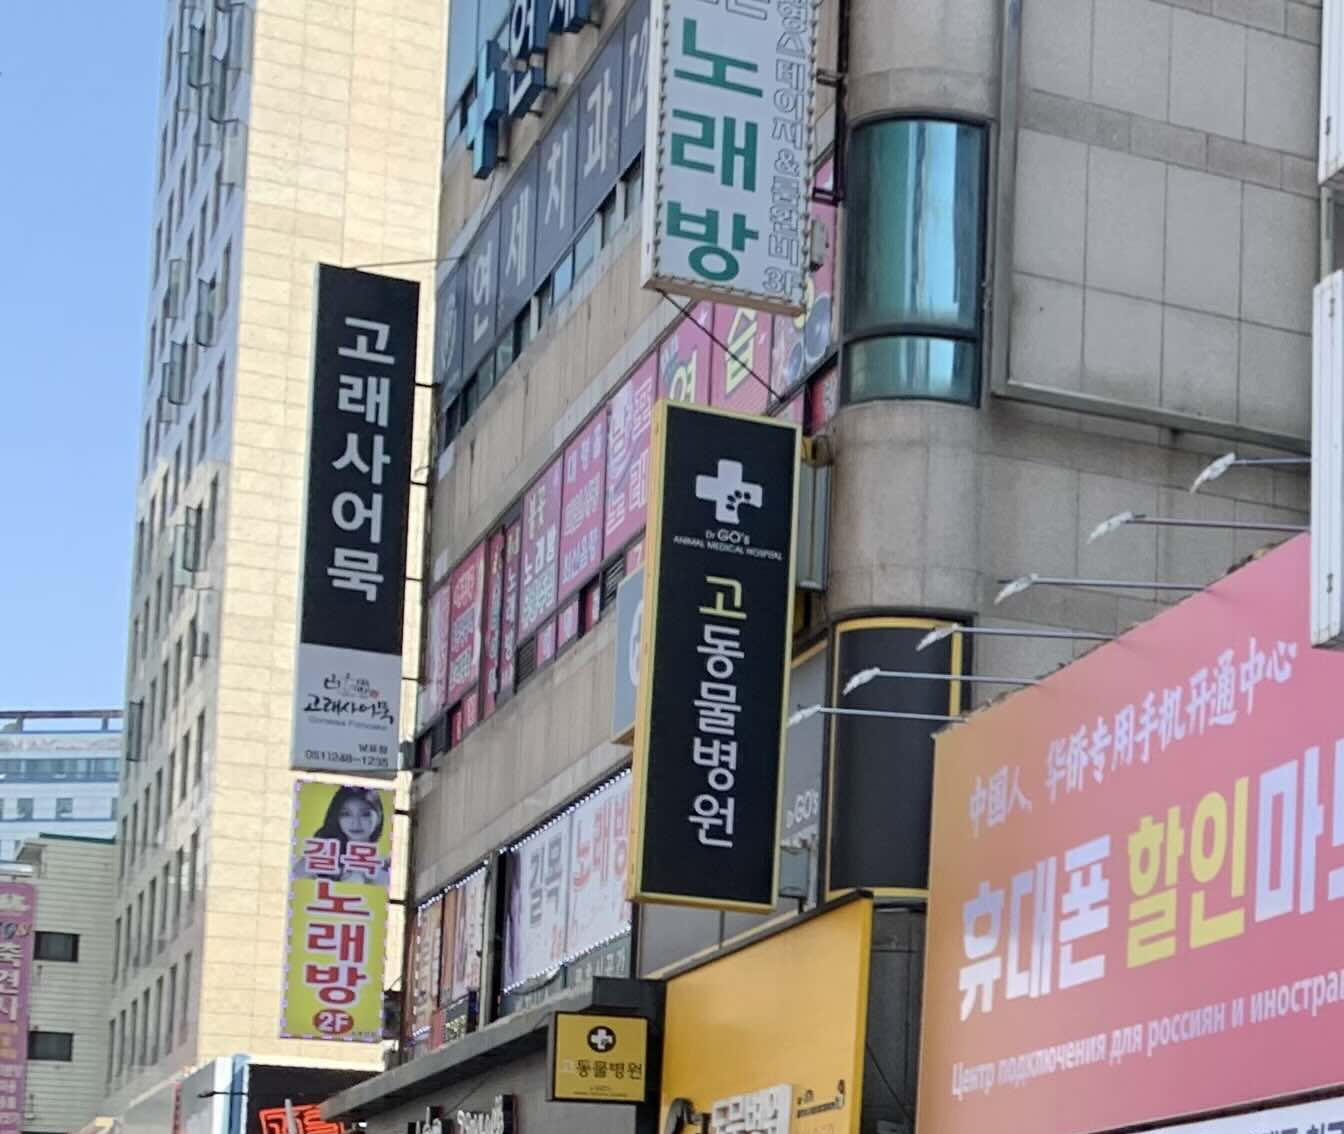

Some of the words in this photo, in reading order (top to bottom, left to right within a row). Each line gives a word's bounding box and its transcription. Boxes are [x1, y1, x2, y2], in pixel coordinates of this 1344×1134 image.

[667, 17, 764, 283] 노래방
[325, 315, 397, 603] 고래사어묵
[687, 574, 747, 849] 고동물병원
[304, 838, 385, 875] 길목
[960, 834, 1111, 1022] 휴대폰
[305, 881, 370, 1005] 노래방
[317, 1012, 349, 1032] 2F
[951, 1058, 995, 1099] Центр
[997, 1032, 1107, 1088] подключения
[1109, 1021, 1144, 1064] для
[1147, 1003, 1226, 1056] россиян
[1231, 1001, 1245, 1029] и
